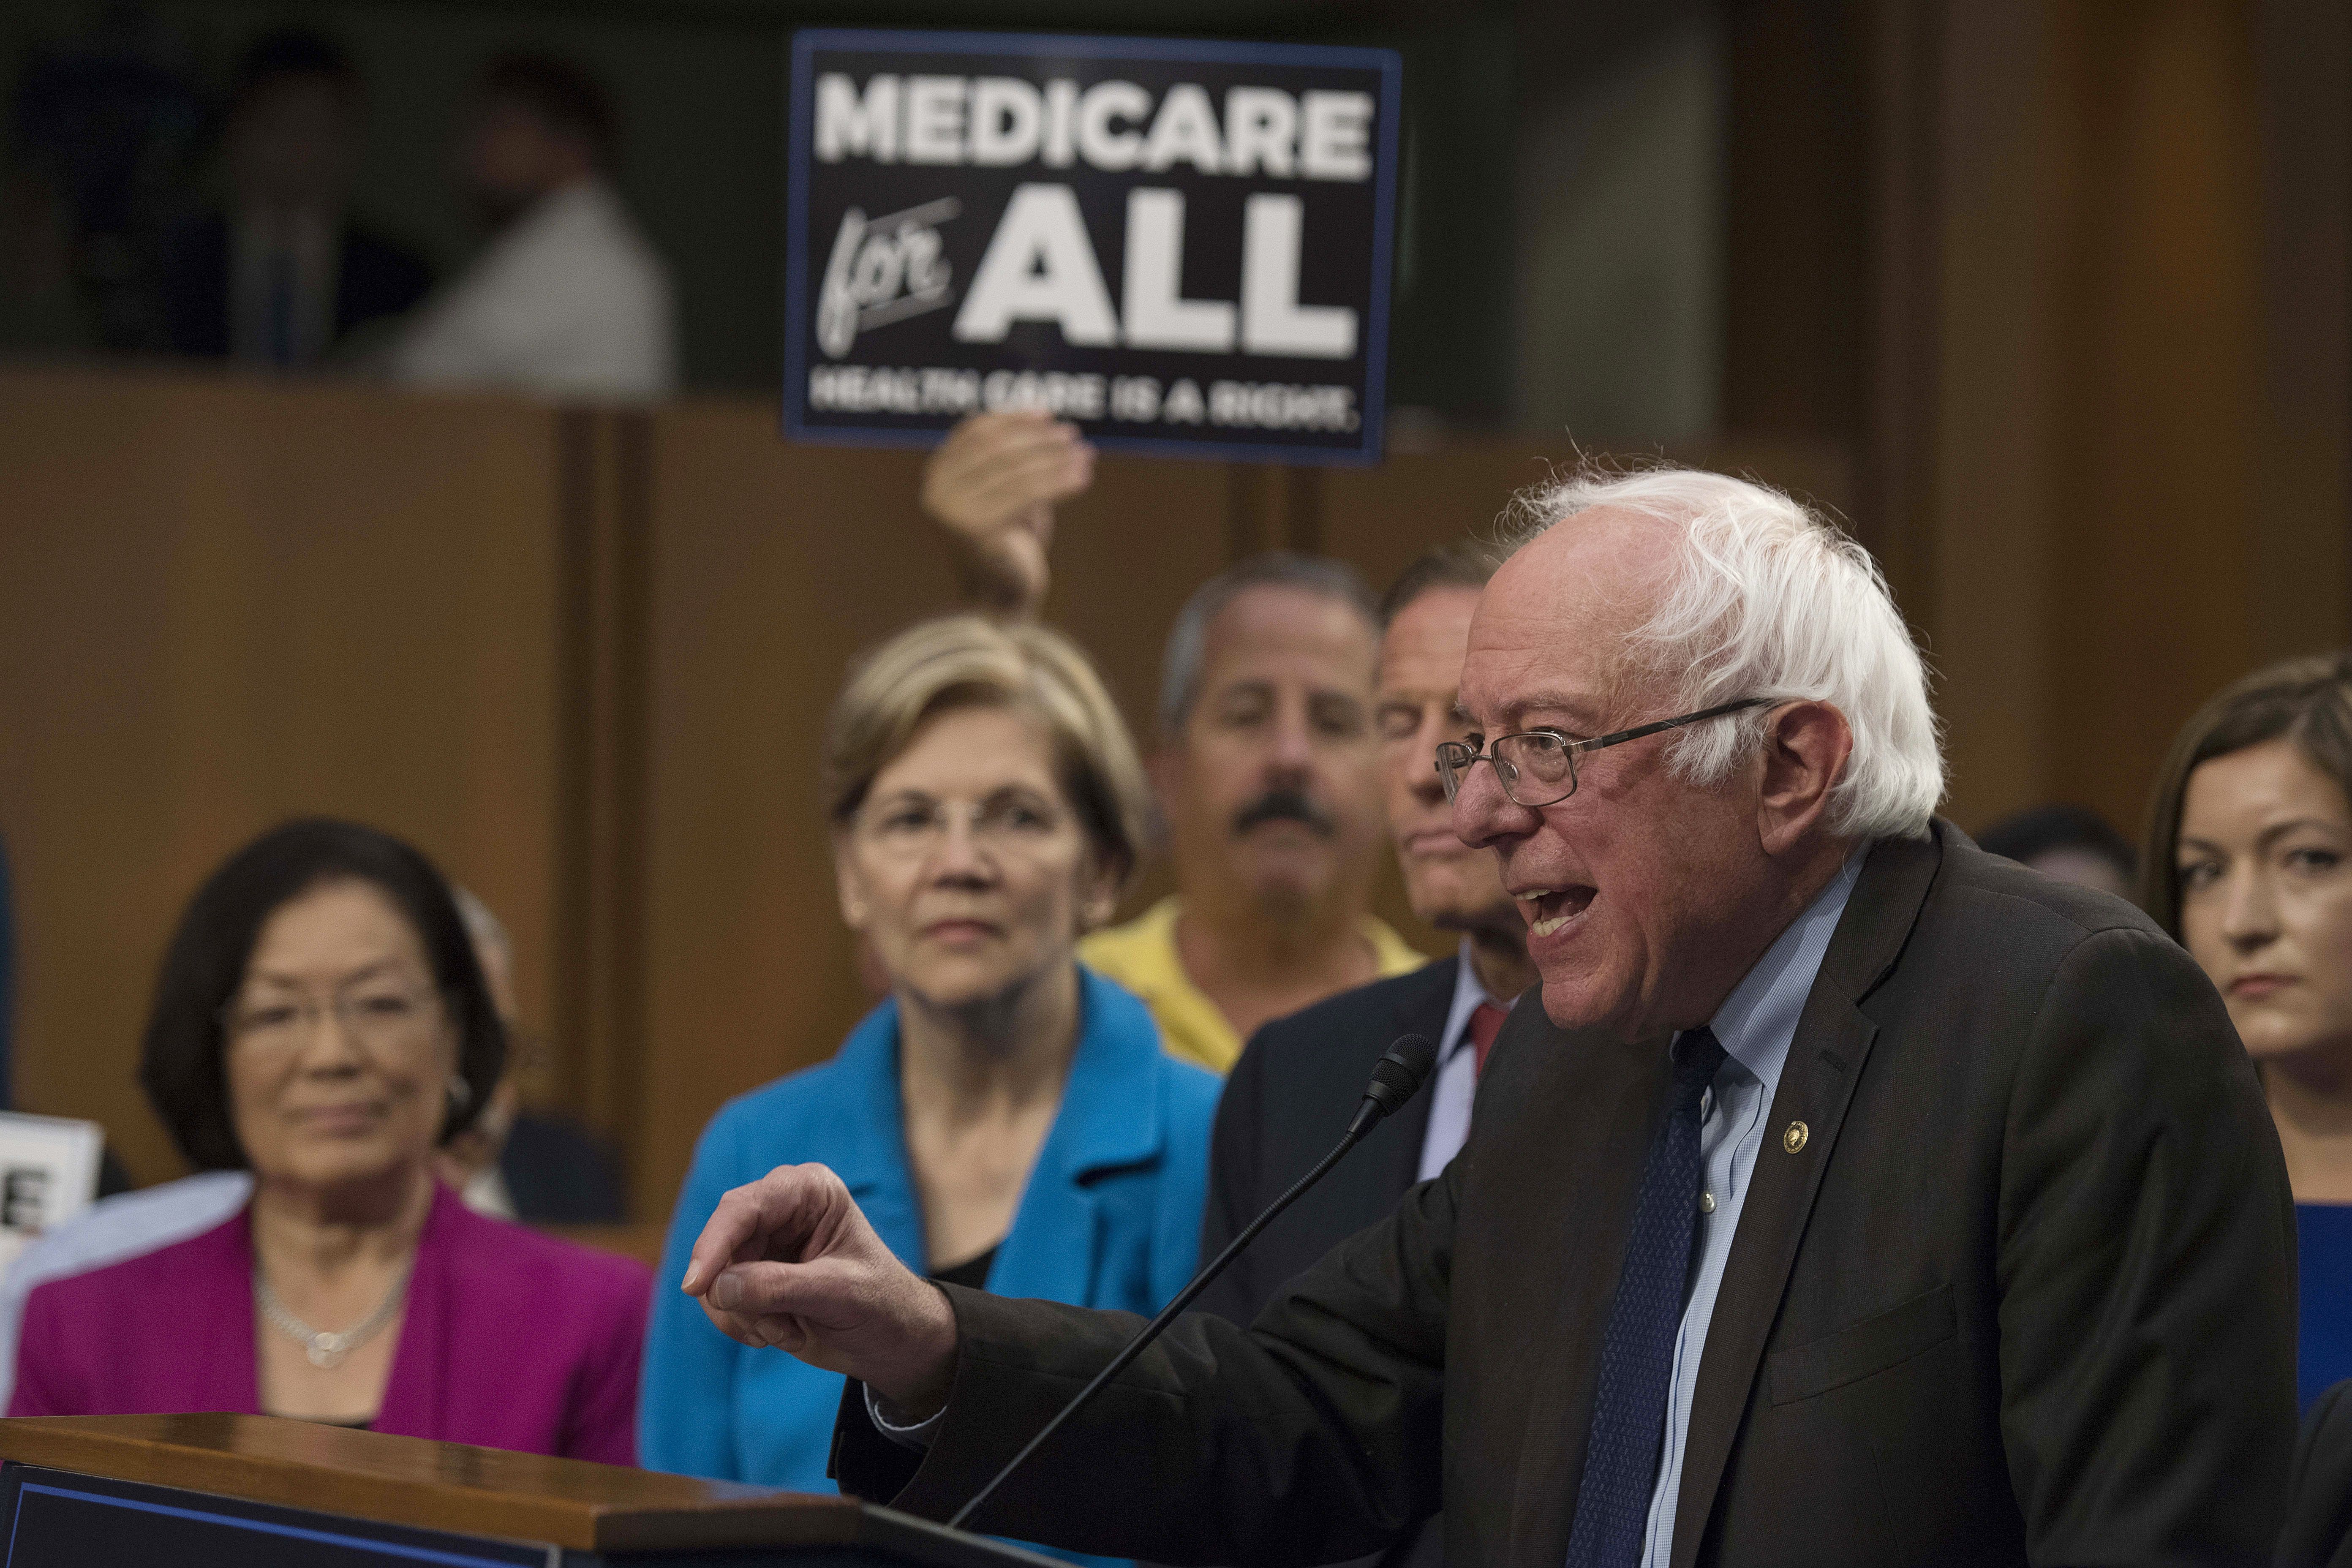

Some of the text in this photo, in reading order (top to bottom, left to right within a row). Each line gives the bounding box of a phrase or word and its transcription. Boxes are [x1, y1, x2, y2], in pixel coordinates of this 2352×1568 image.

[815, 74, 1375, 182] MEDICARE
[817, 182, 1358, 359] for ALL
[808, 364, 1361, 433] HEALTH CARE IS A RIGHT.
